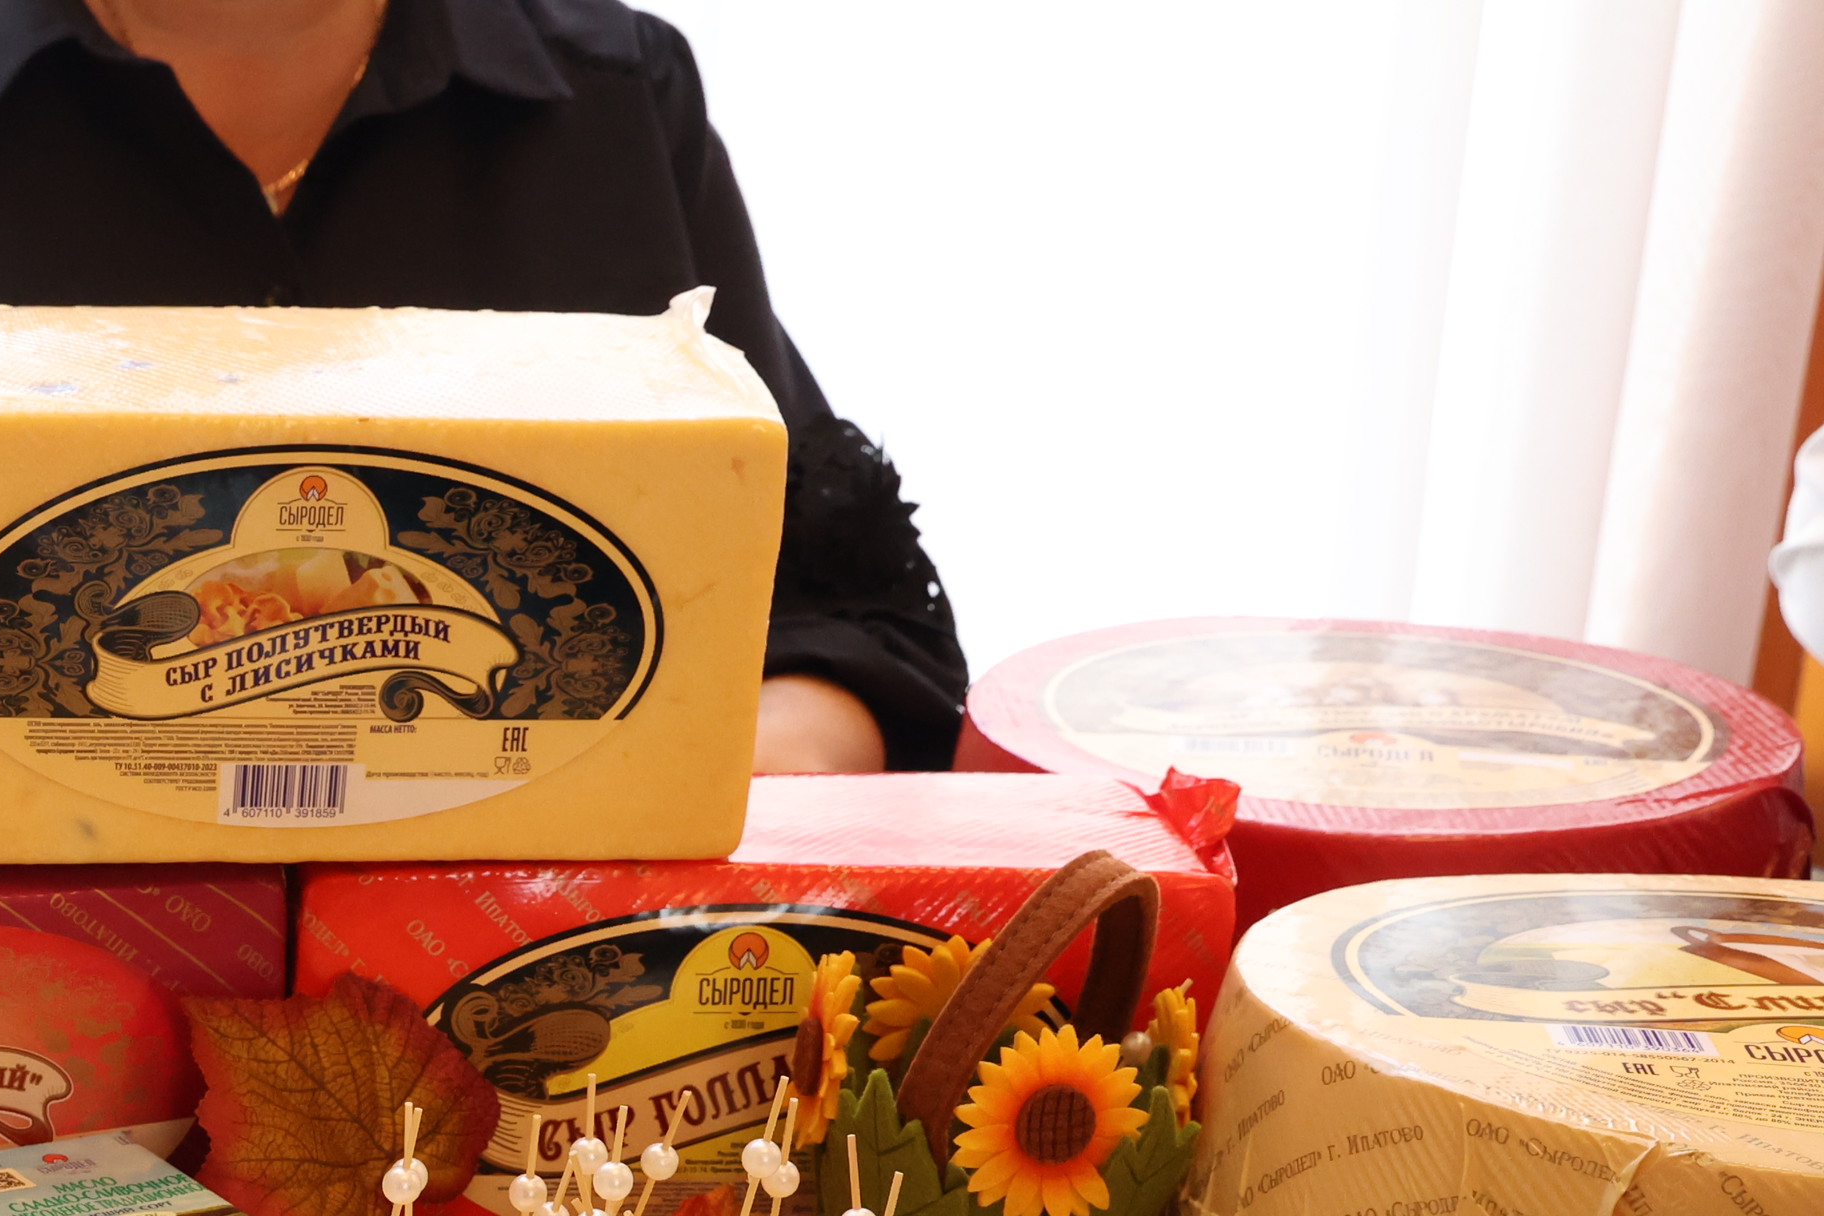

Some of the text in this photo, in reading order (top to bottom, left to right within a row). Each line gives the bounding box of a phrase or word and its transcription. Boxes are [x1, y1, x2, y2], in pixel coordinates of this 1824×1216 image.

[279, 505, 344, 527] СЫРОДЕЛ
[165, 614, 452, 687] СЫР ПОЛУТВЕРДЫЙ
[201, 639, 421, 702] С ЛИСИЧКАМИ
[370, 725, 417, 733] МАССА НЕТТО:
[223, 807, 336, 818] 4 607110 391859
[406, 918, 447, 957] ОАО
[698, 977, 795, 1010] СЫРОДЕЛ
[1321, 1060, 1356, 1086] ОАО
[1347, 1124, 1424, 1156] ИПАТОВО
[1466, 1118, 1510, 1145] ОАО
[53, 1176, 117, 1193] МАСЛО
[139, 1200, 172, 1211] СОРТ
